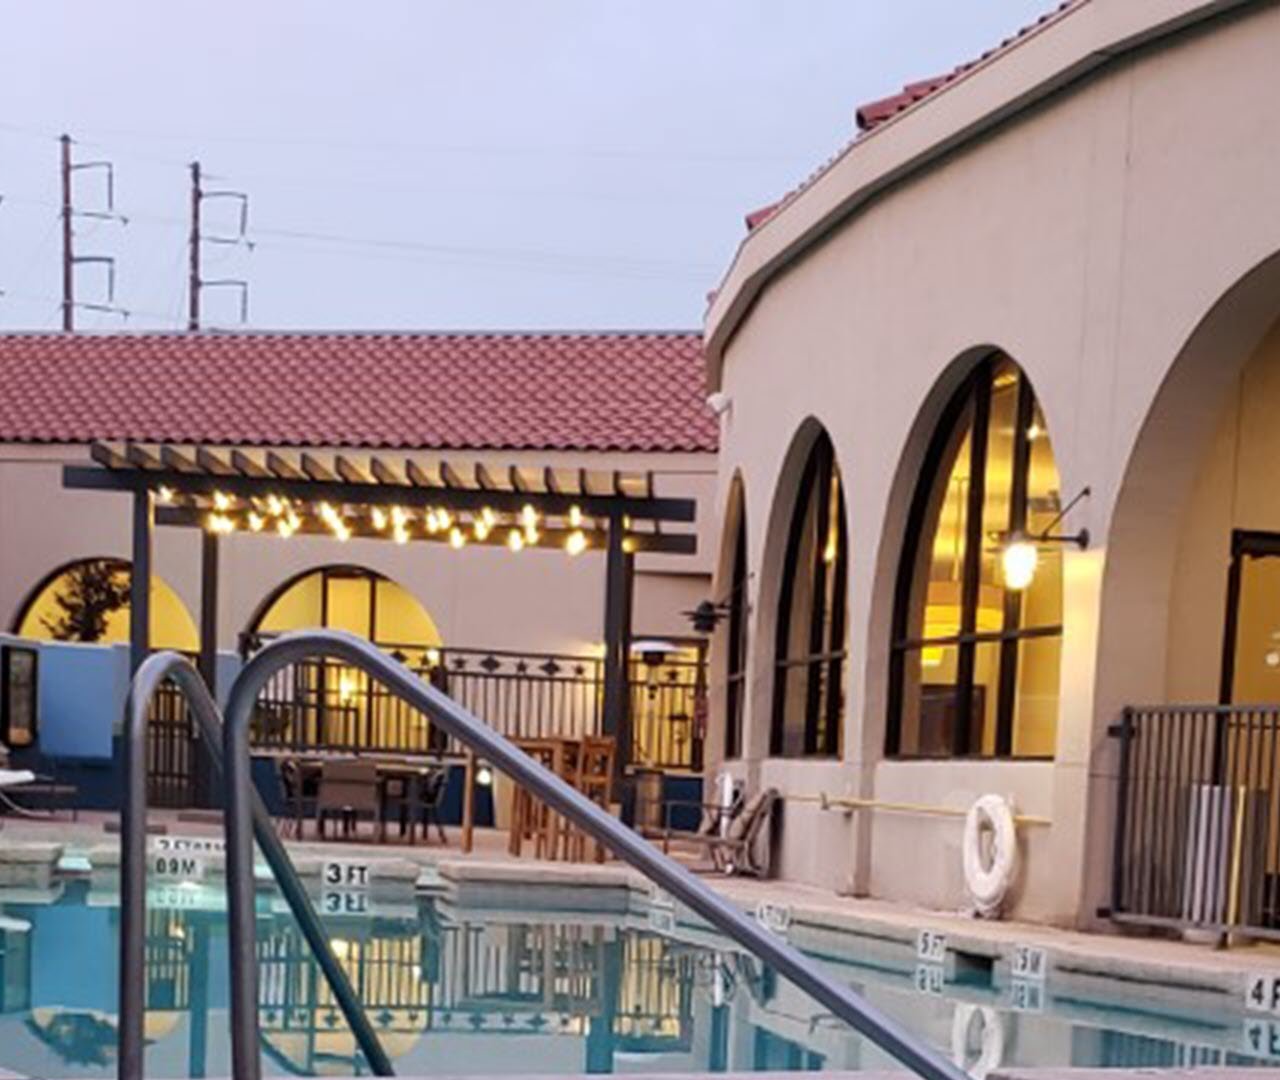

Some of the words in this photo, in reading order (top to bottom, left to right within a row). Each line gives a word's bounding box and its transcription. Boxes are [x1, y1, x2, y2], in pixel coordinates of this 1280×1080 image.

[326, 863, 341, 884] 3
[347, 865, 368, 885] FT
[1251, 978, 1265, 1006] 4
